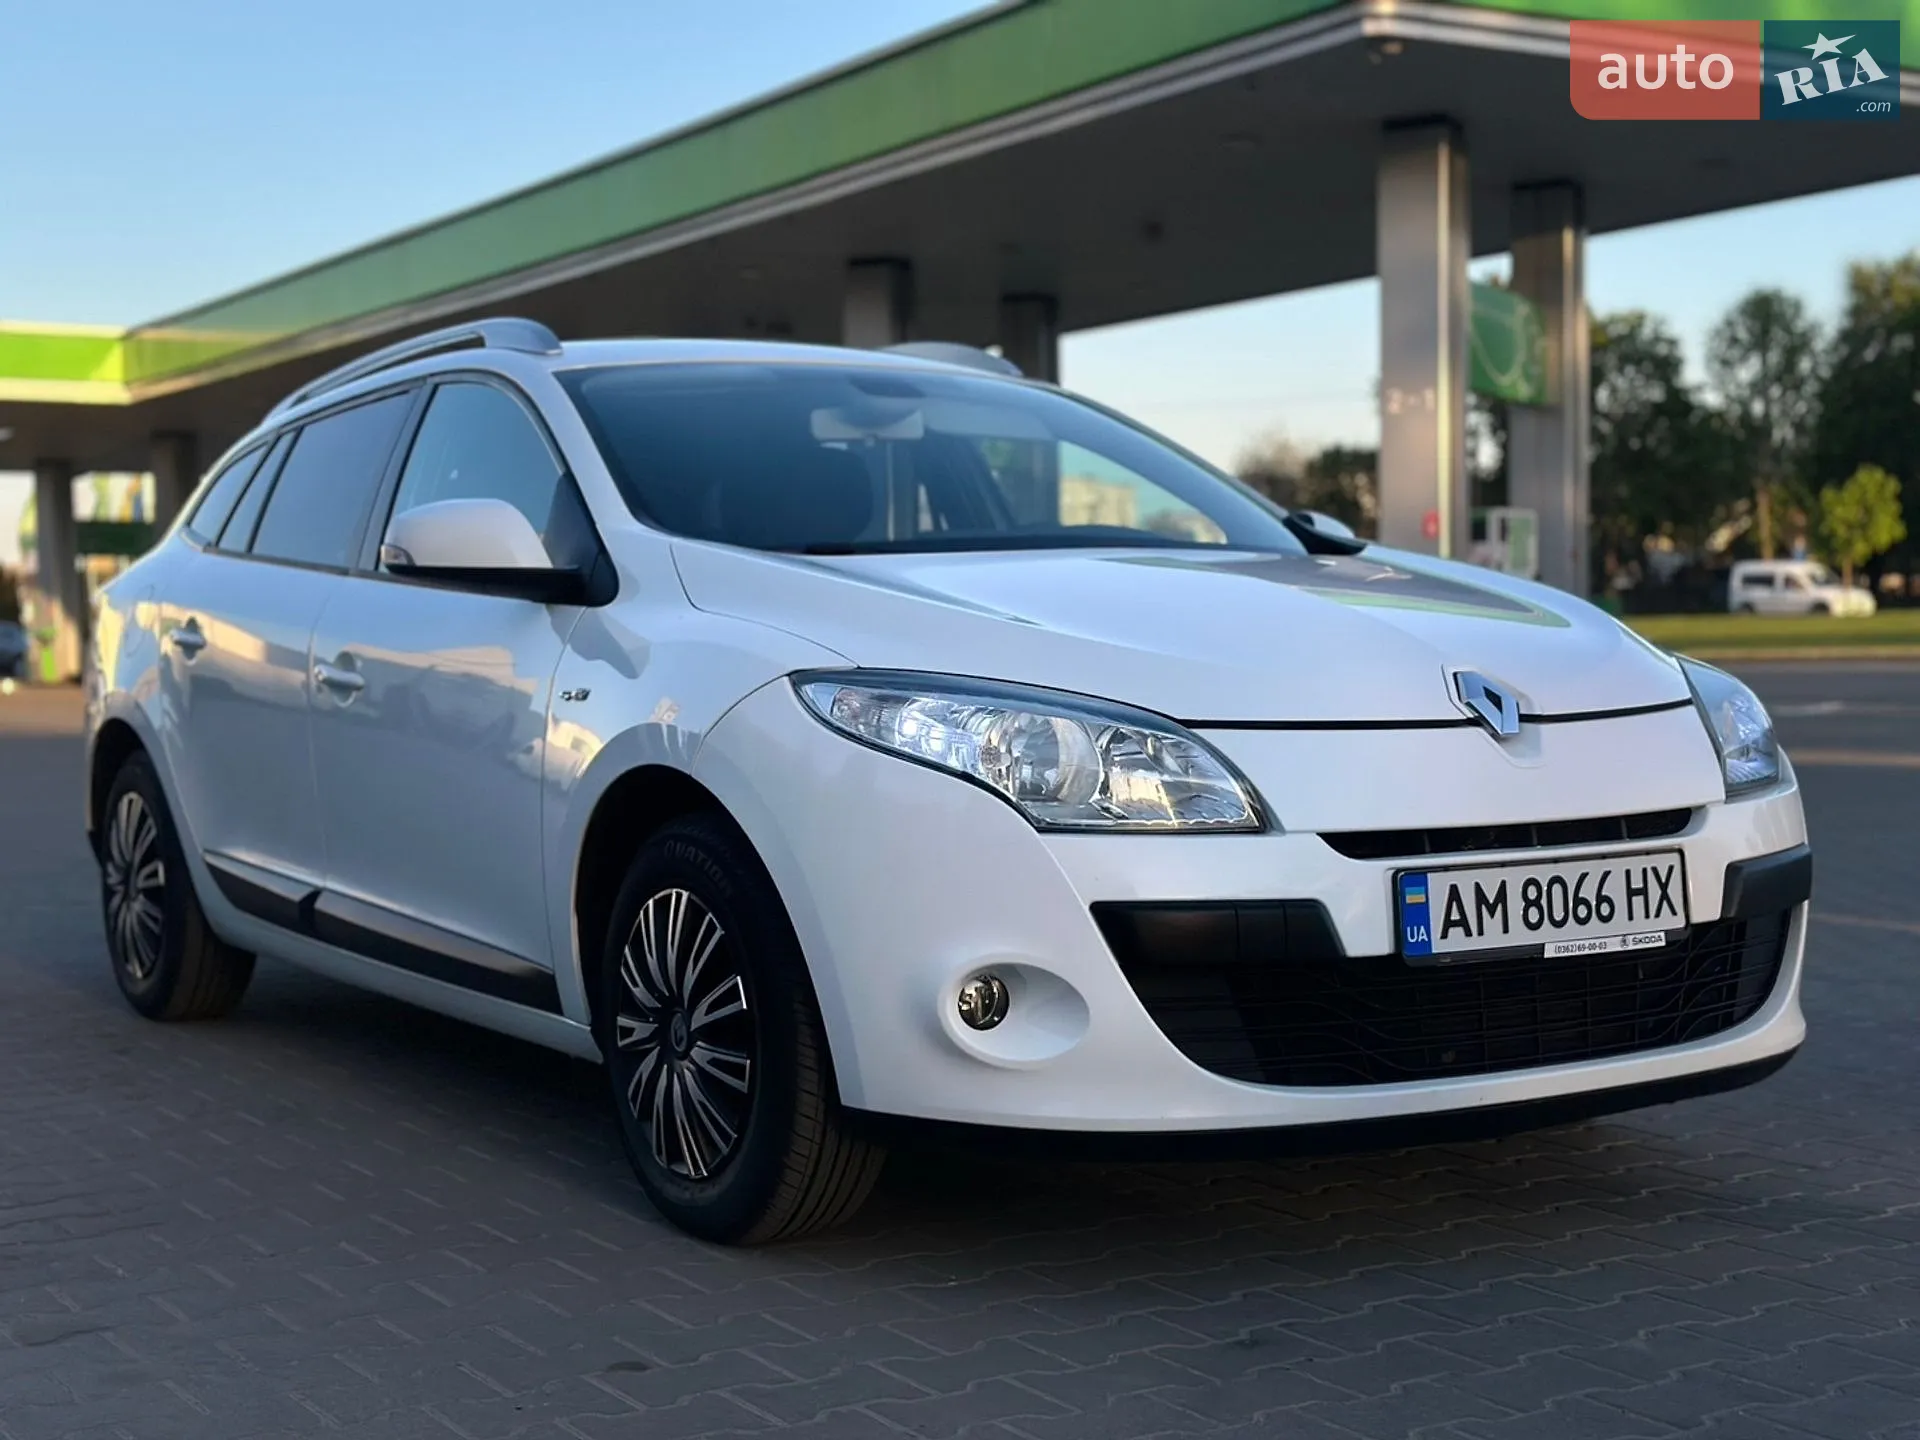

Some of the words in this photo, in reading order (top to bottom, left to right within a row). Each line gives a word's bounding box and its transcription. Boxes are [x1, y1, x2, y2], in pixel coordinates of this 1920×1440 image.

[663, 839, 734, 899] OVATION
[1439, 879, 1510, 940] AM
[1520, 869, 1616, 932] 8066
[1624, 863, 1679, 922] HX
[1406, 925, 1429, 944] UA
